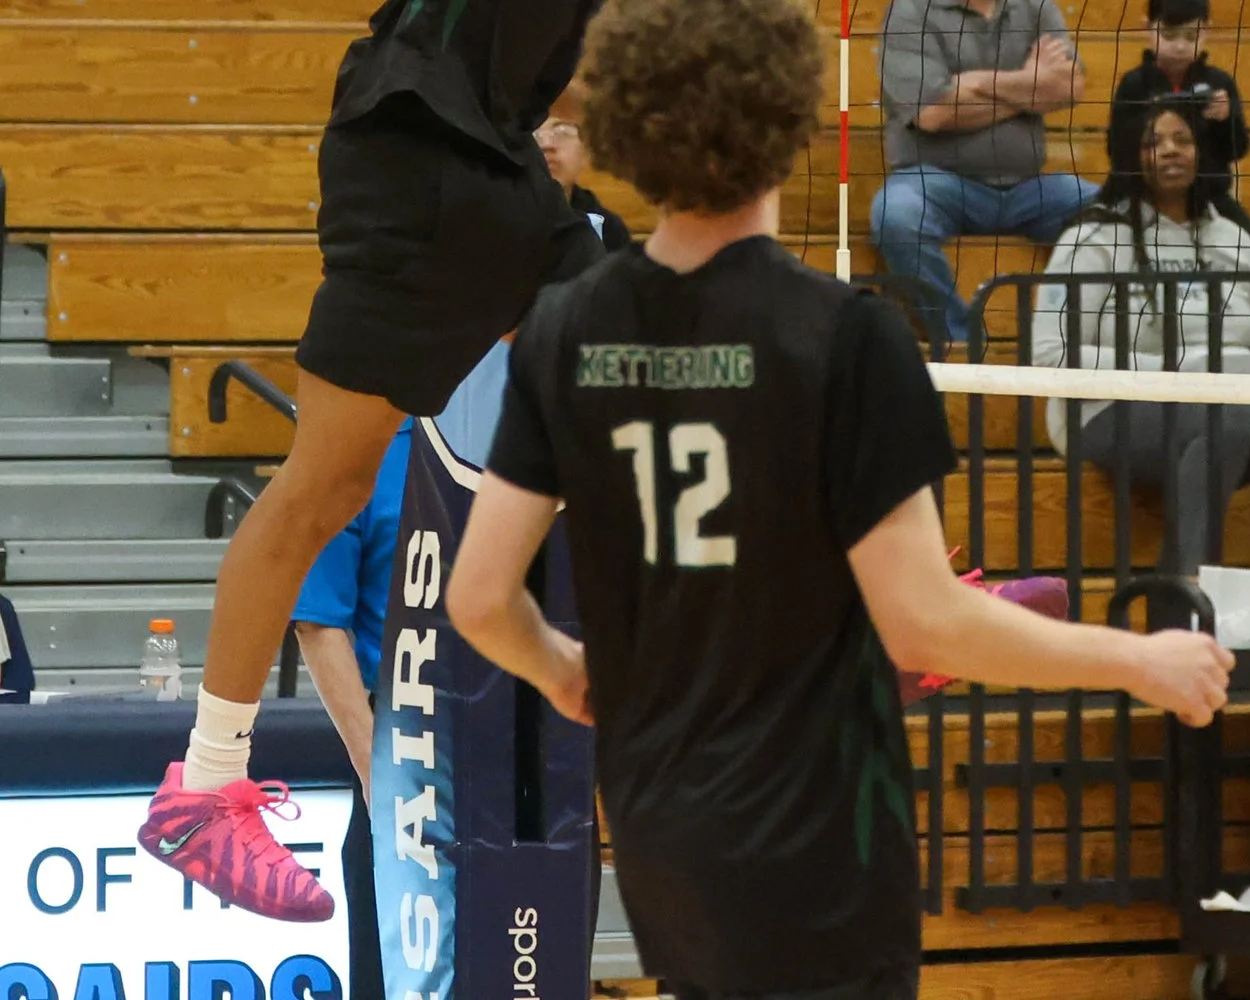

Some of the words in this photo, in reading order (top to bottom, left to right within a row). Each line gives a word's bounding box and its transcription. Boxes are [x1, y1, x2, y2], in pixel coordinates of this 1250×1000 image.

[577, 344, 755, 389] KETTERING
[611, 420, 736, 567] 12
[392, 530, 441, 1000] SAIRS
[27, 847, 136, 915] OF
[508, 906, 538, 1000] spor
